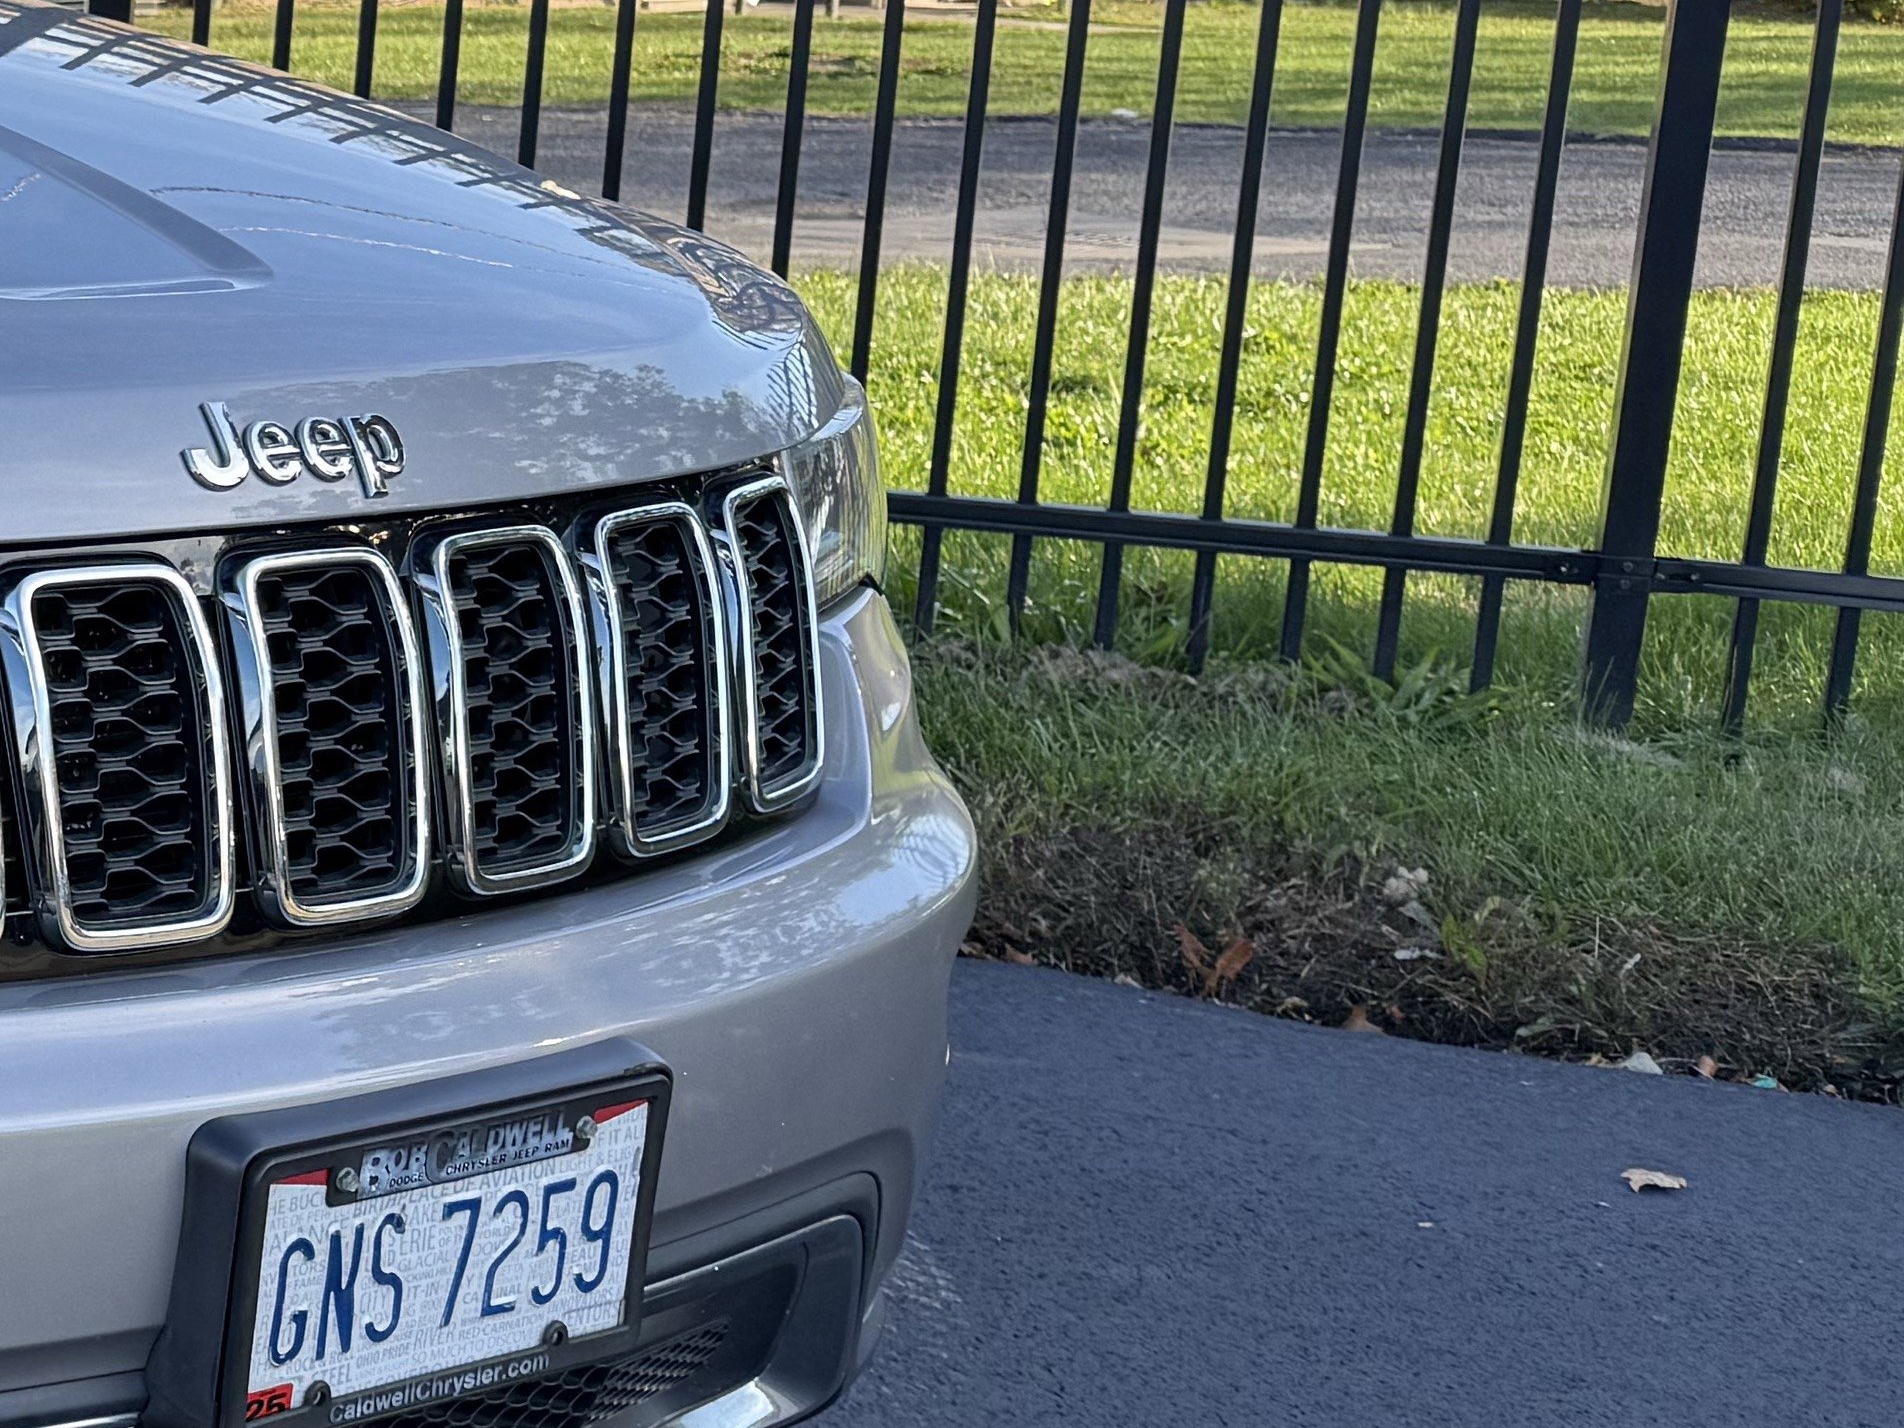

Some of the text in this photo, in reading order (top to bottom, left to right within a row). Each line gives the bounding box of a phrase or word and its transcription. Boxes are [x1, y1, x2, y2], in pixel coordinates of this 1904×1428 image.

[179, 400, 406, 499] Jeep
[359, 1109, 574, 1194] BOB CALDWELL
[388, 1138, 571, 1189] DODGE CHRYSLER JEEP RAM
[269, 1211, 407, 1367] GNS
[439, 1169, 620, 1328] 7259
[245, 1392, 288, 1423] 25
[329, 1353, 550, 1423] CaldwellChrysler.com
